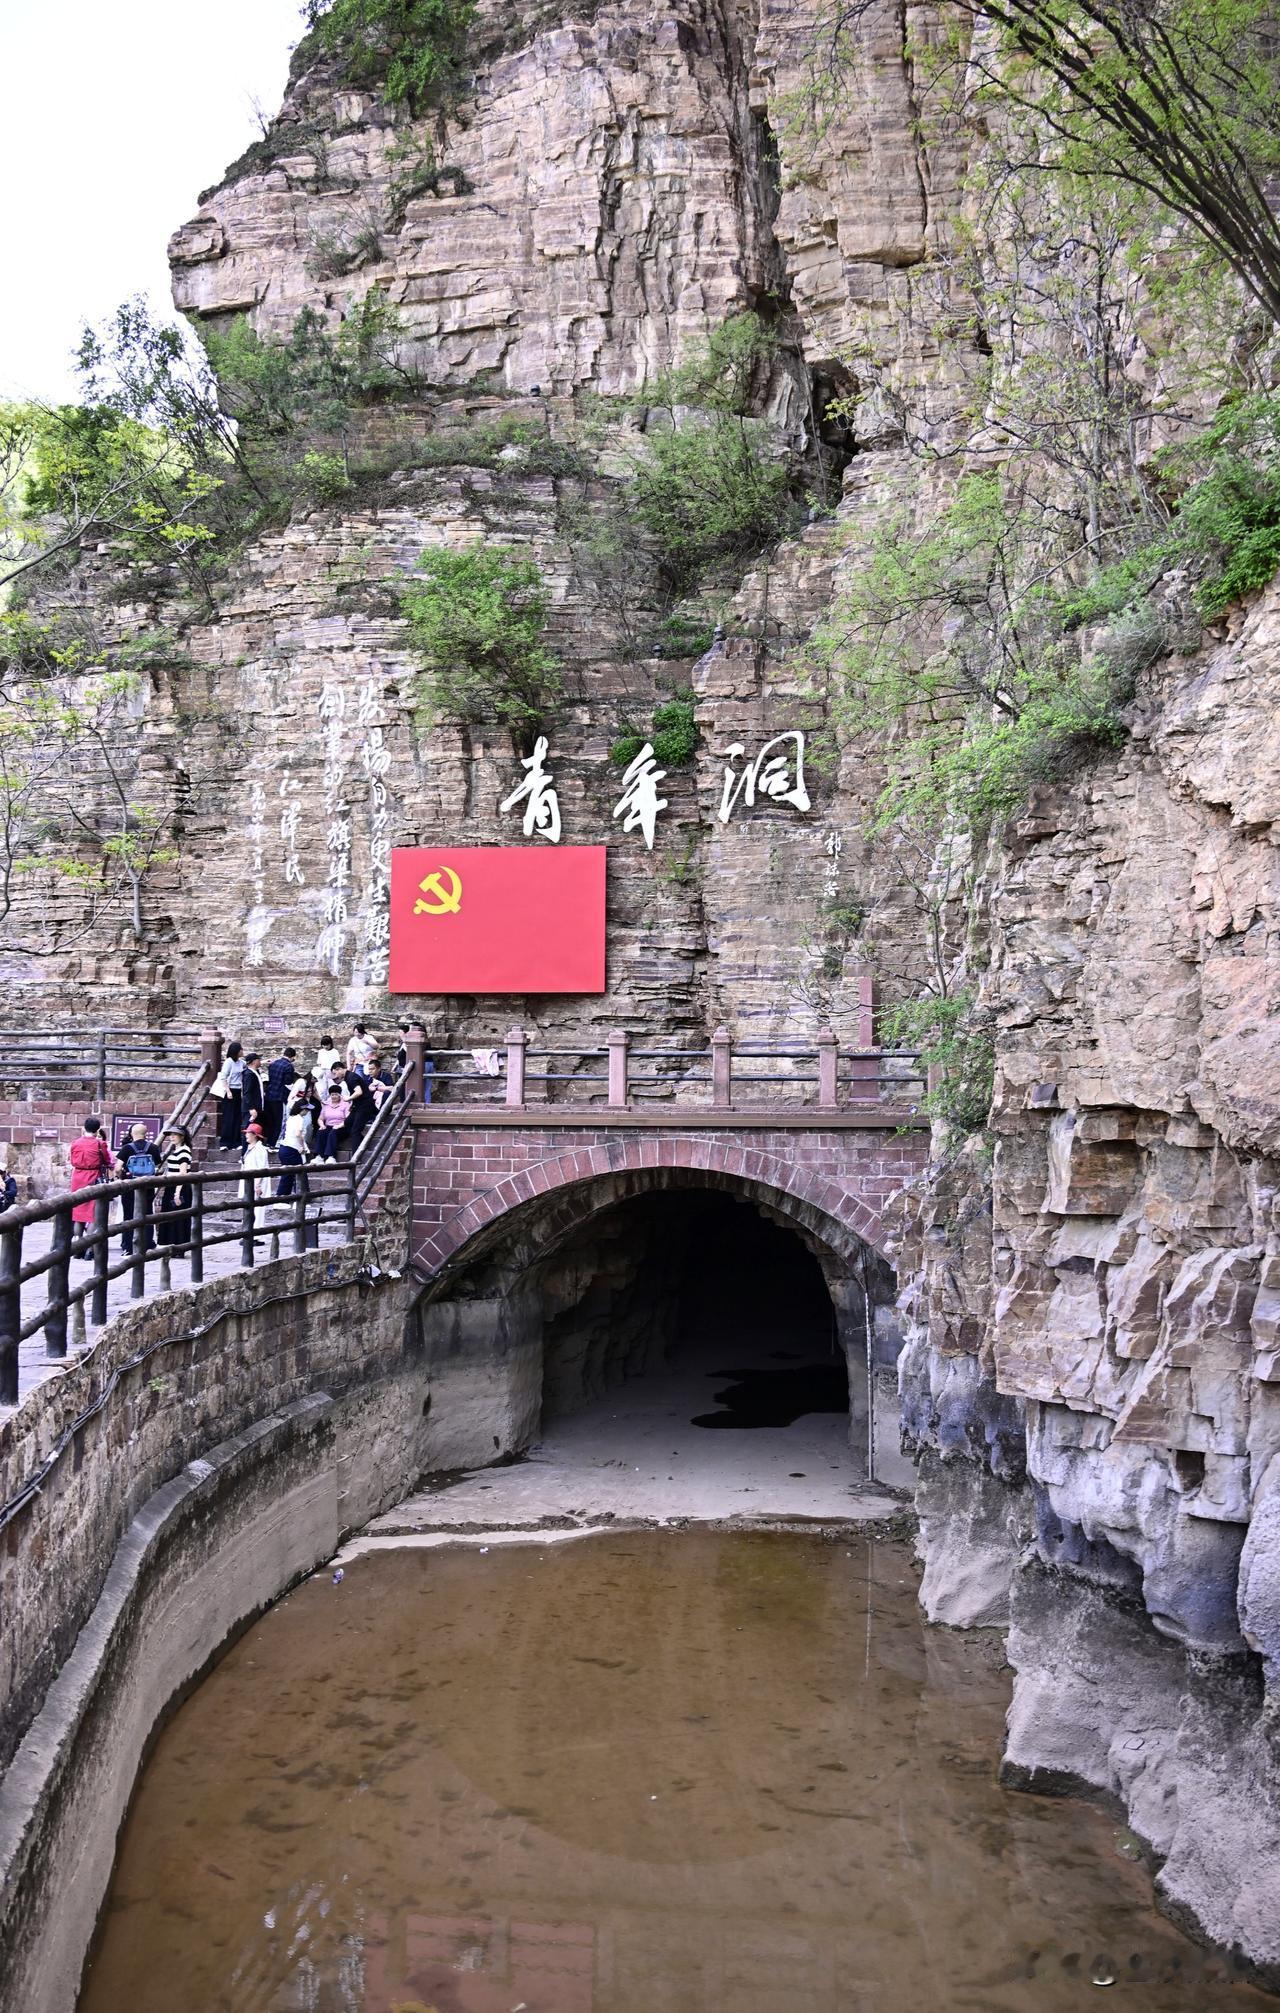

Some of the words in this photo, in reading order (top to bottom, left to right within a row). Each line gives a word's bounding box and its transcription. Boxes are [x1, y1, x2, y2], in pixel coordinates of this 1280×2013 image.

[500, 730, 811, 851] 青年洞
[823, 831, 842, 897] 郭沫若
